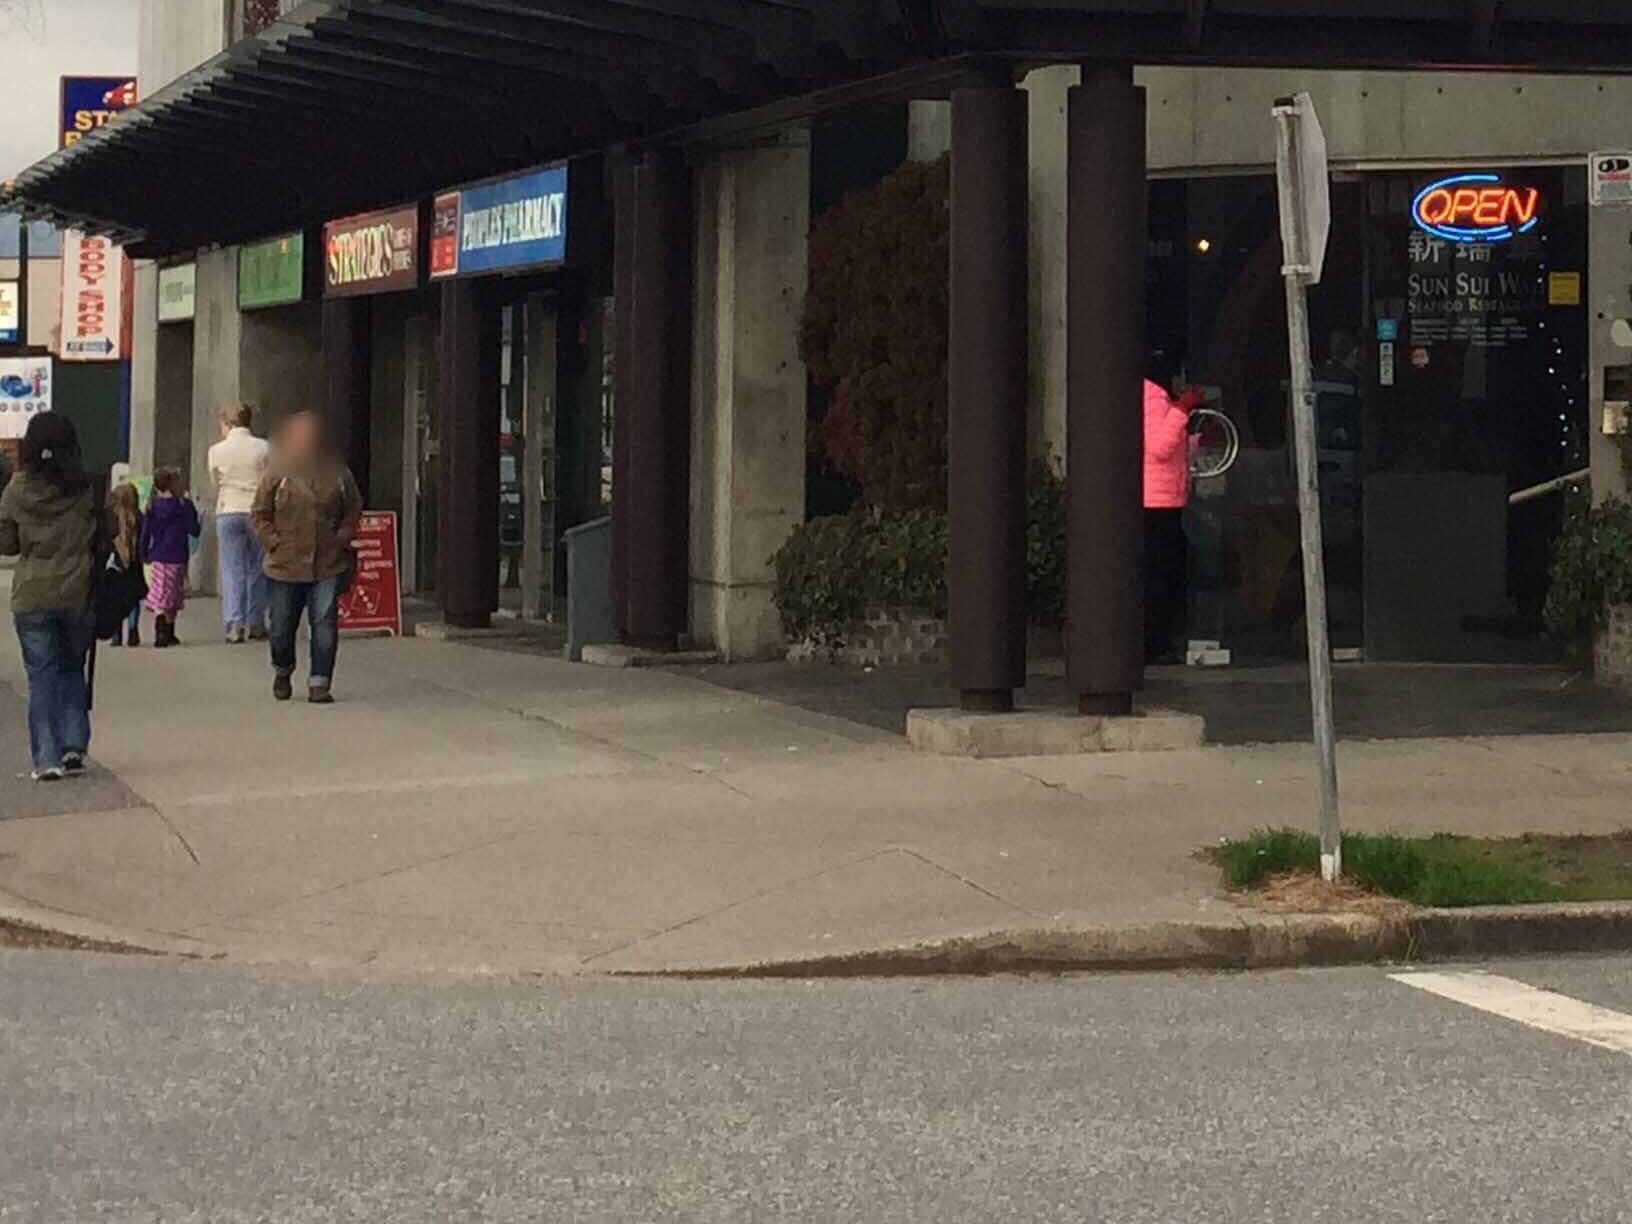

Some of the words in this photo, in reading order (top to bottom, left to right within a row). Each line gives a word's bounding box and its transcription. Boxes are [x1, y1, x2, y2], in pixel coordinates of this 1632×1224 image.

[1420, 187, 1538, 224] OPEN
[79, 238, 105, 285] BODY
[1407, 273, 1449, 296] SUN
[1456, 273, 1490, 295] SUI
[77, 290, 105, 337] SHOP
